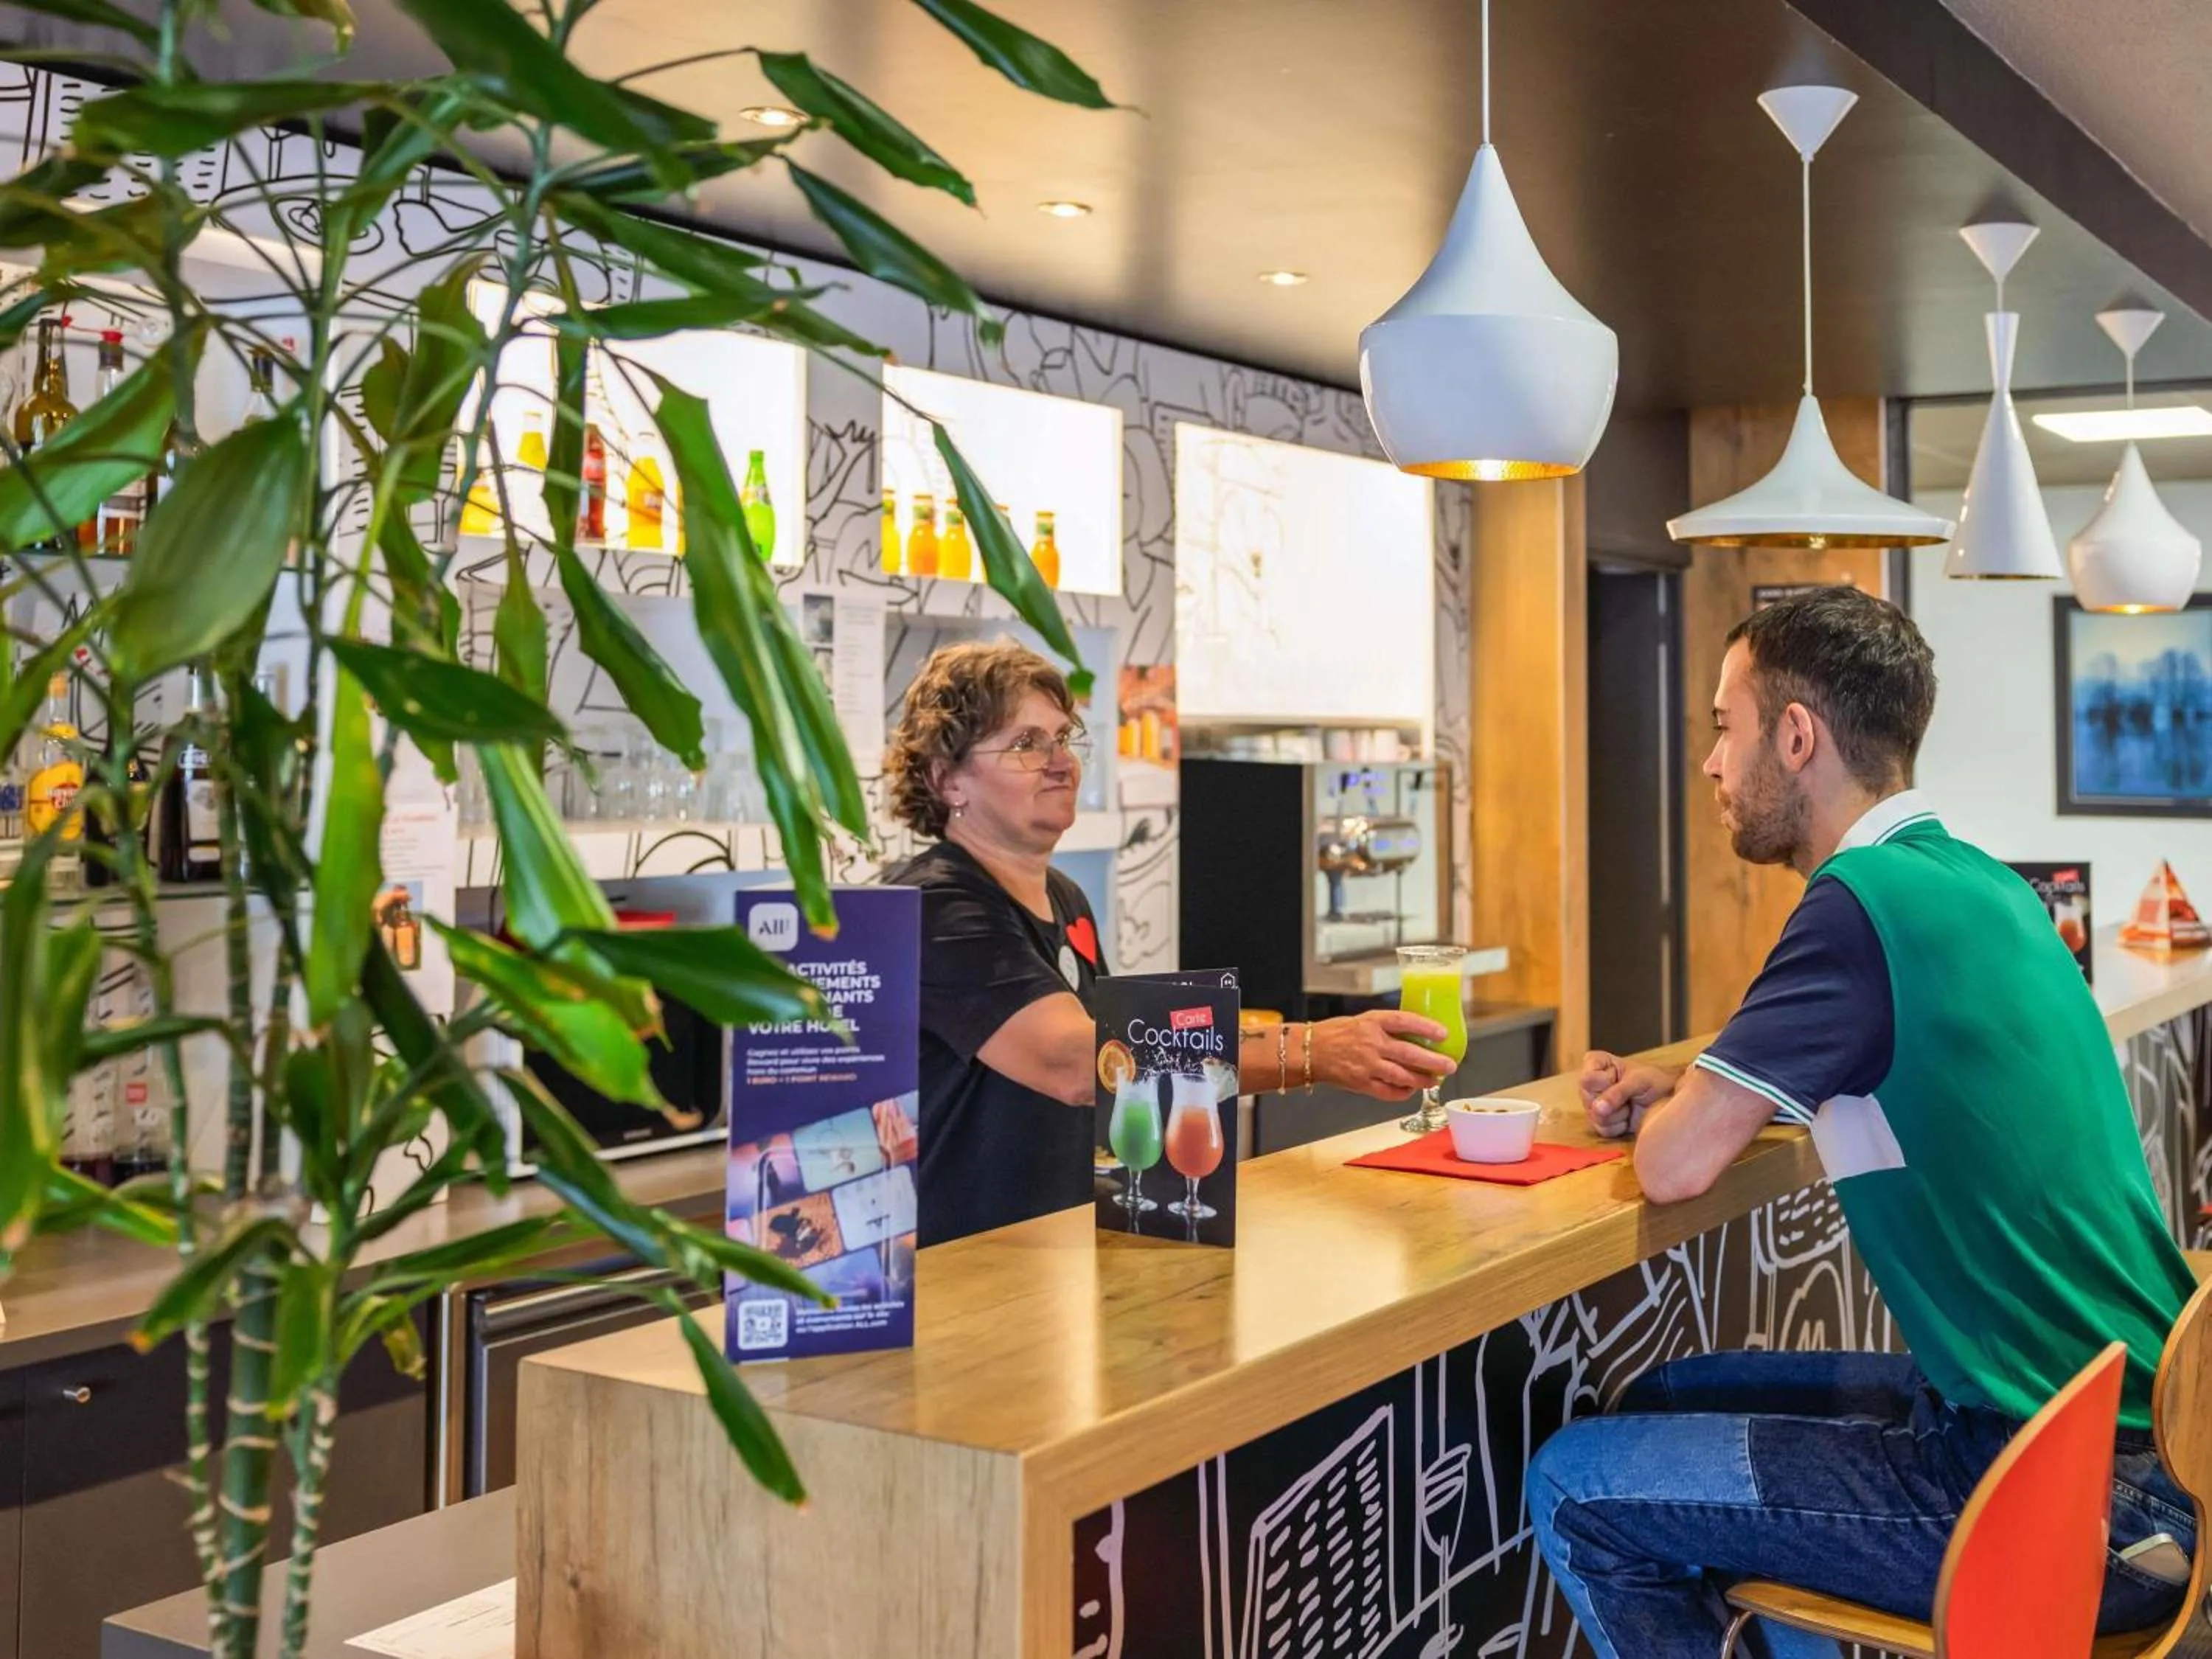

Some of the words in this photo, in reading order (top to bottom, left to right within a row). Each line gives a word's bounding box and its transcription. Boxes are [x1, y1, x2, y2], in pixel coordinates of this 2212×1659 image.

[811, 975, 881, 990] EMENTS
[1176, 1012, 1207, 1026] Carte
[1127, 1018, 1224, 1051] Cocktails
